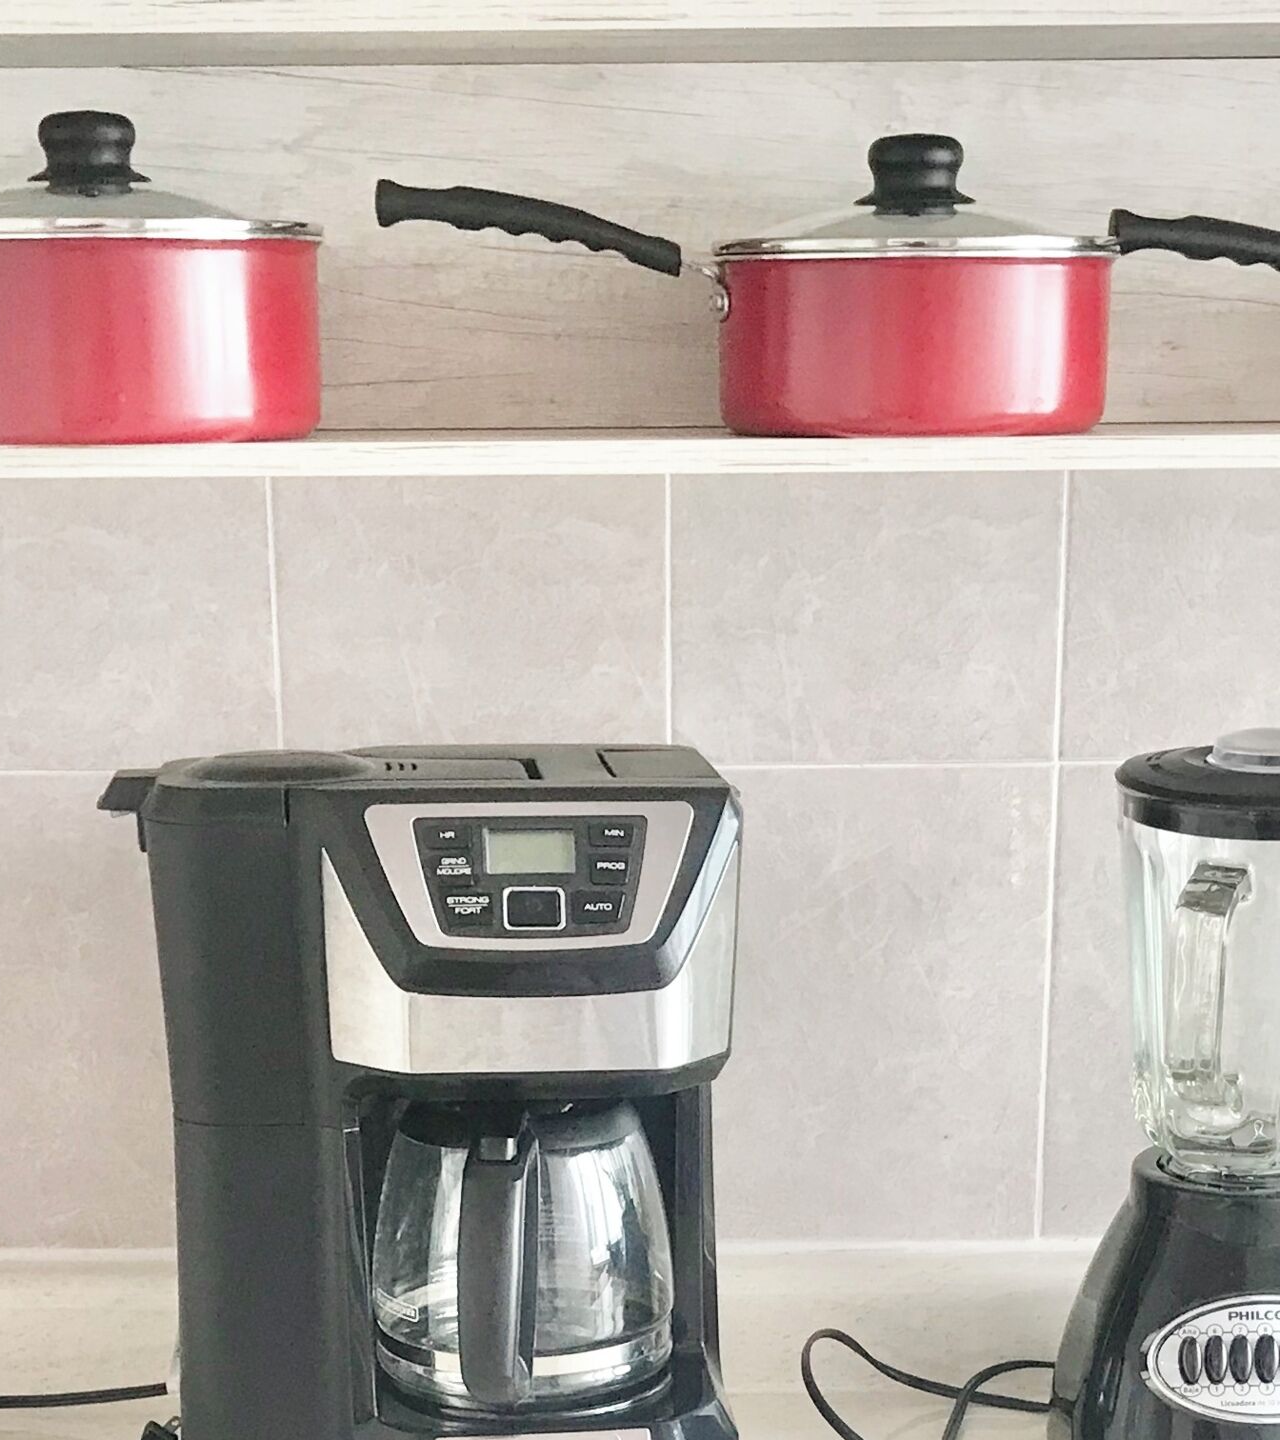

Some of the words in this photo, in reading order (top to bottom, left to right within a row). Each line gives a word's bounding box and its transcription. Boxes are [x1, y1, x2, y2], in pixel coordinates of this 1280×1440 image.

[439, 831, 455, 839] HR
[604, 829, 625, 837] MIN
[441, 857, 467, 865] GRIND
[596, 862, 626, 870] PROG
[446, 896, 490, 904] STRONG
[454, 906, 482, 914] FORT
[584, 903, 613, 911] AUTO
